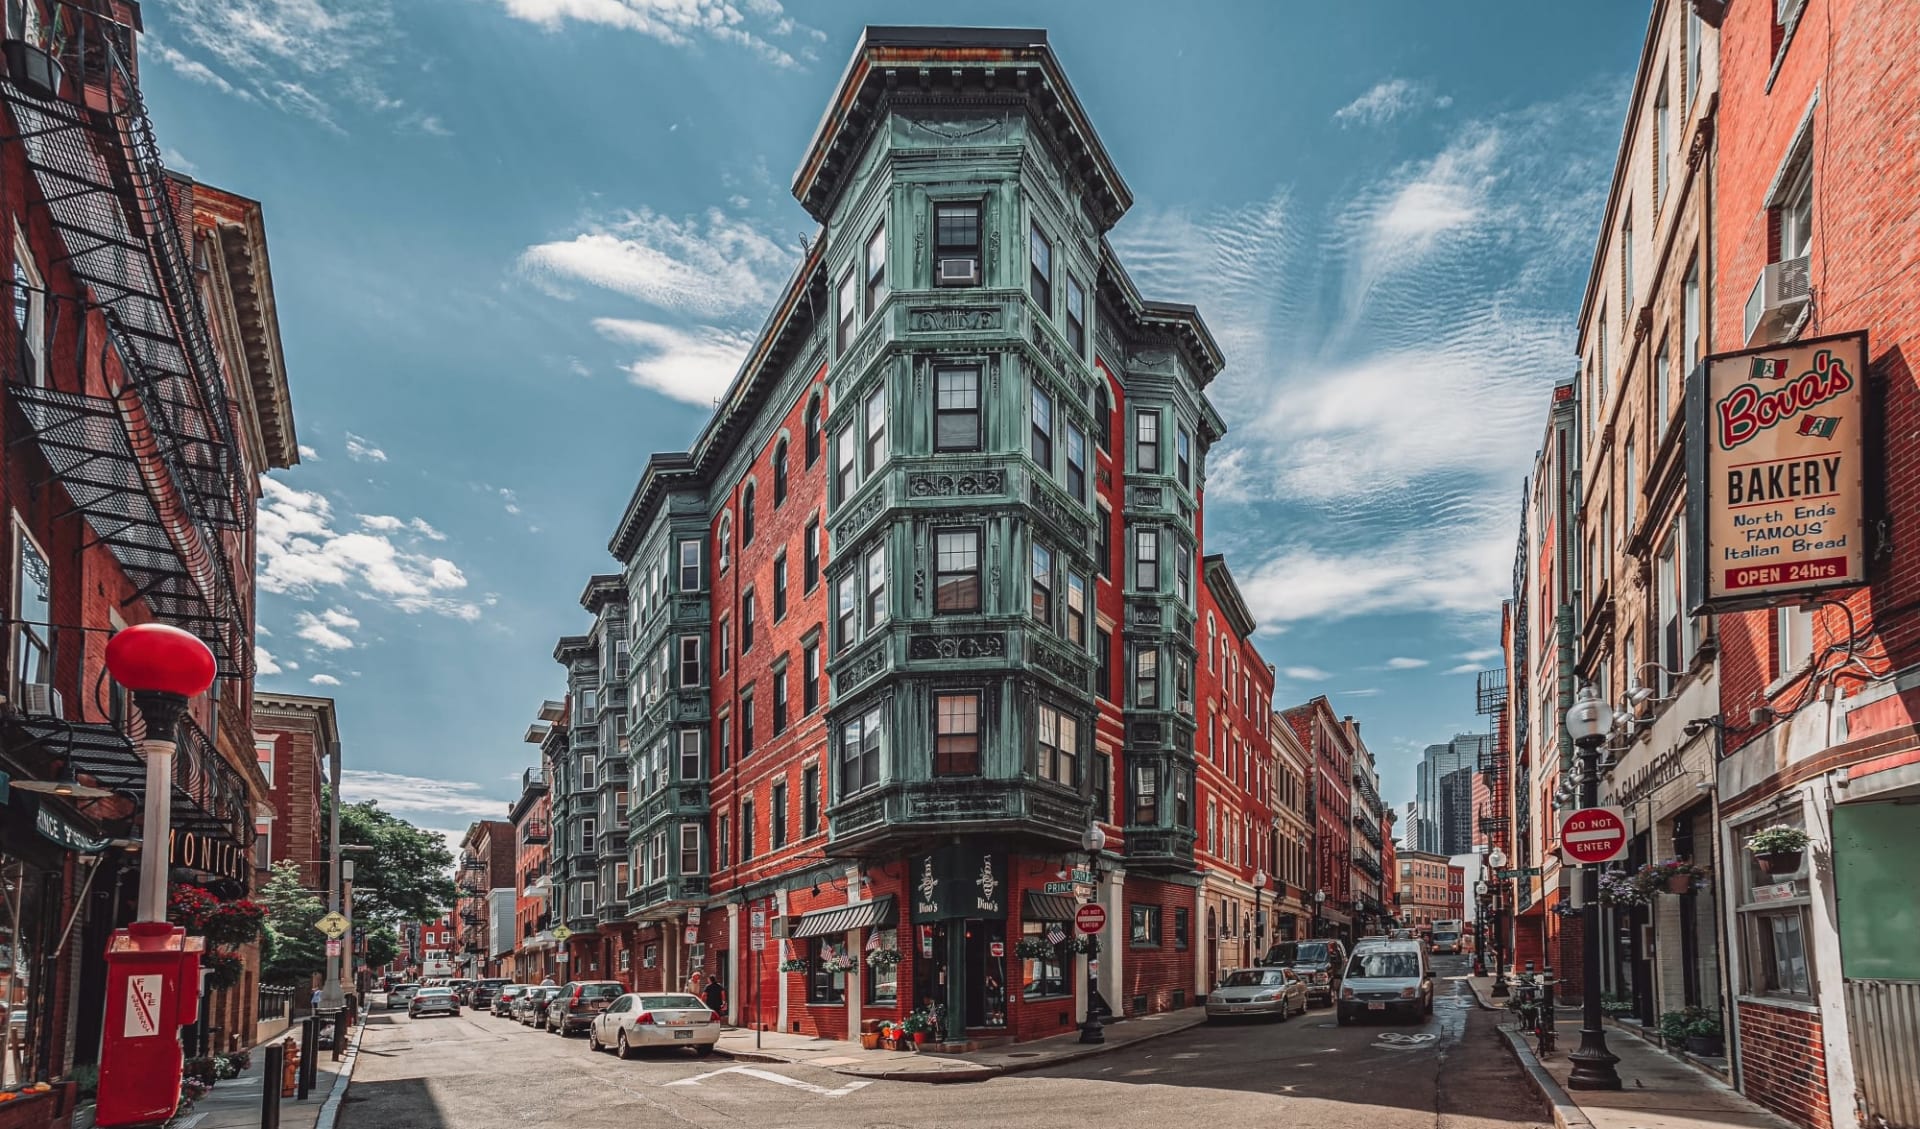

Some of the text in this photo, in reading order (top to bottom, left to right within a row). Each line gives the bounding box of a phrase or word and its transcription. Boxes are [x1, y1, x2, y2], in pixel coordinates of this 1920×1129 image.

[1716, 350, 1853, 450] Bova's
[1728, 457, 1841, 505] BAKERY
[1733, 502, 1836, 527] North End's
[1724, 535, 1847, 561] Italian Bread
[1737, 562, 1836, 586] OPEN 24hrs
[1621, 744, 1682, 807] SALUMERIA
[1571, 818, 1612, 830] DO NOT
[1576, 841, 1611, 852] ENTER
[1047, 883, 1072, 893] PRINC
[919, 900, 938, 913] Dino's
[977, 897, 998, 912] Dino's
[136, 978, 156, 1006] FIRE
